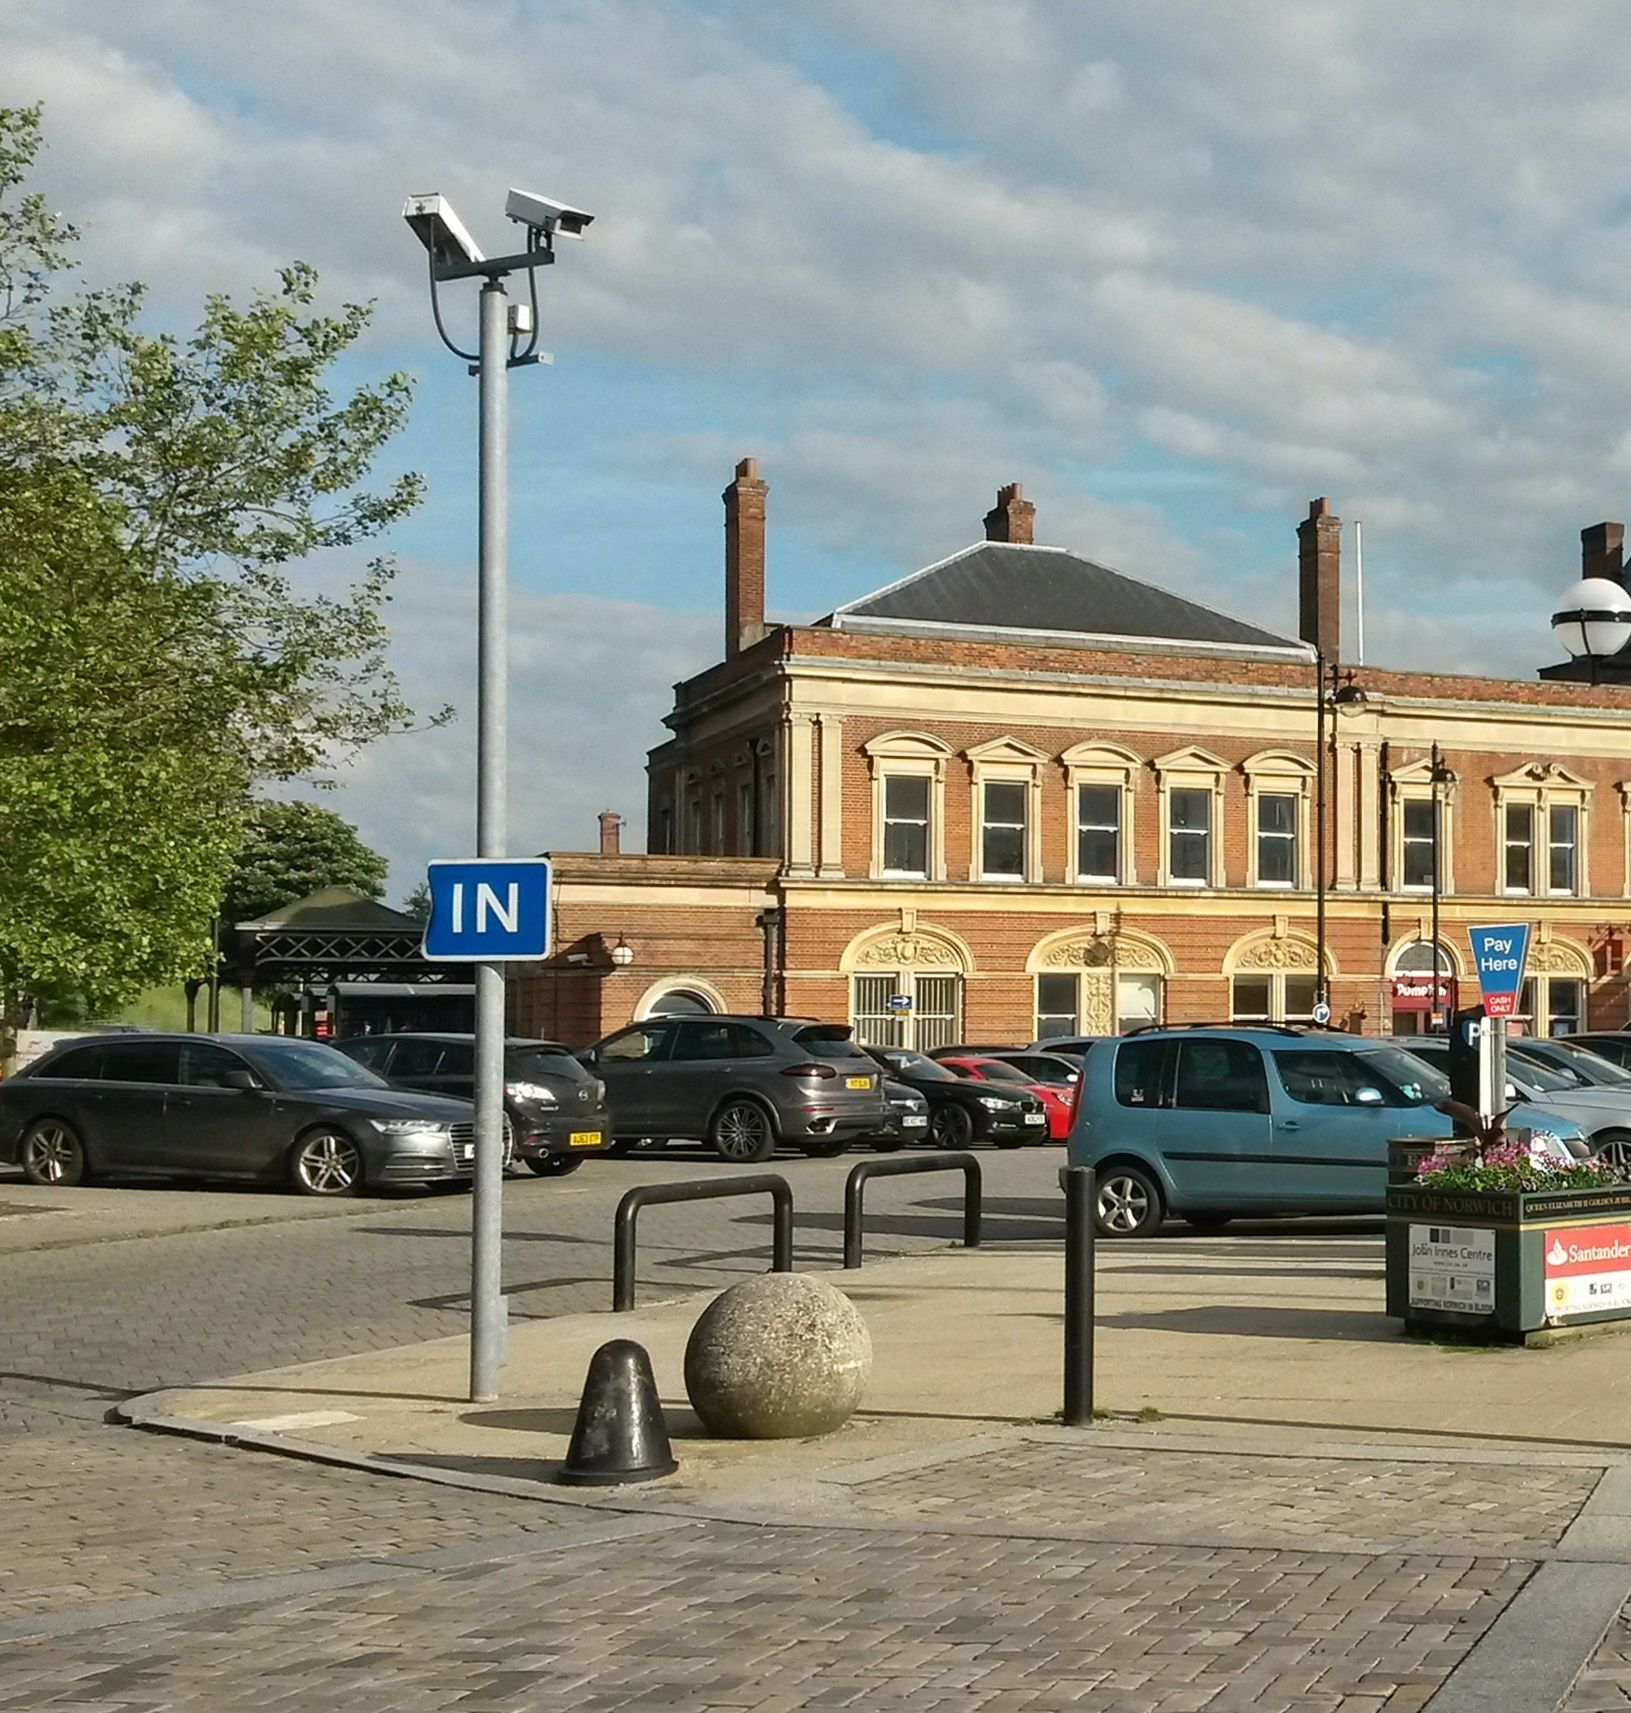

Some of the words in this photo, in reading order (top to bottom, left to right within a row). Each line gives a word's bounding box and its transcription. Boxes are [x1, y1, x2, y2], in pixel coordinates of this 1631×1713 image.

[452, 882, 519, 934] IN
[1483, 937, 1513, 955] Pay
[1481, 958, 1519, 973] Here
[1396, 983, 1447, 997] Pumpkn
[1489, 996, 1511, 1005] CASH
[1490, 1004, 1512, 1013] ONLY
[1387, 1194, 1418, 1211] CITY
[1422, 1196, 1441, 1212] OF
[1443, 1198, 1513, 1217] NORWICH
[1525, 1202, 1548, 1213] QUEEN
[1549, 1199, 1582, 1210] ELIZABETH
[1588, 1197, 1613, 1207] GOLDEN
[1434, 1246, 1459, 1259] Innes
[1460, 1247, 1493, 1262] Centre
[1568, 1239, 1631, 1264] Santander
